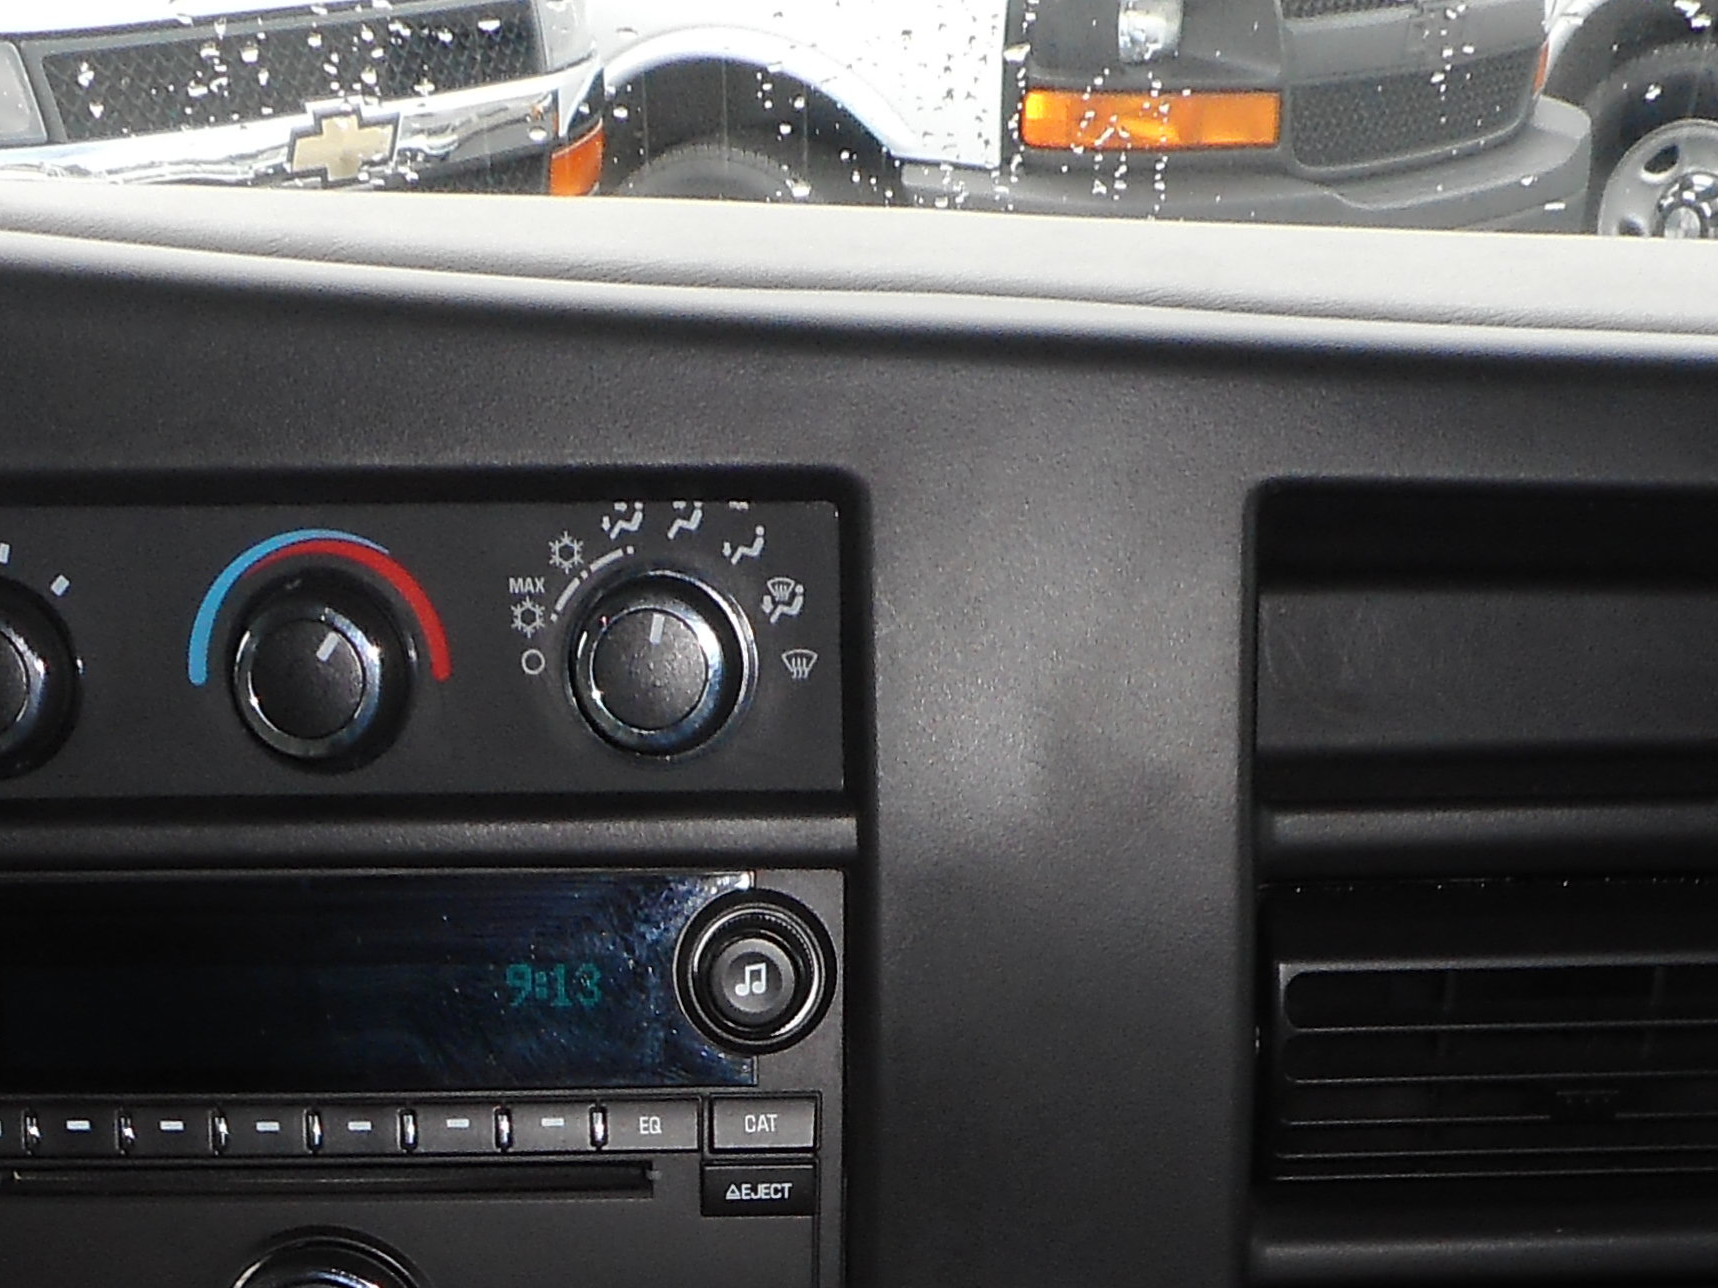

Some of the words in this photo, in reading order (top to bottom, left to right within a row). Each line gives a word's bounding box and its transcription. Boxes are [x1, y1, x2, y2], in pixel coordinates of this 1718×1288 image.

[508, 577, 546, 594] MAX
[506, 963, 602, 1007] 9:13
[639, 1116, 663, 1135] EQ
[744, 1113, 778, 1133] CAT
[740, 1183, 793, 1200] EJECT
